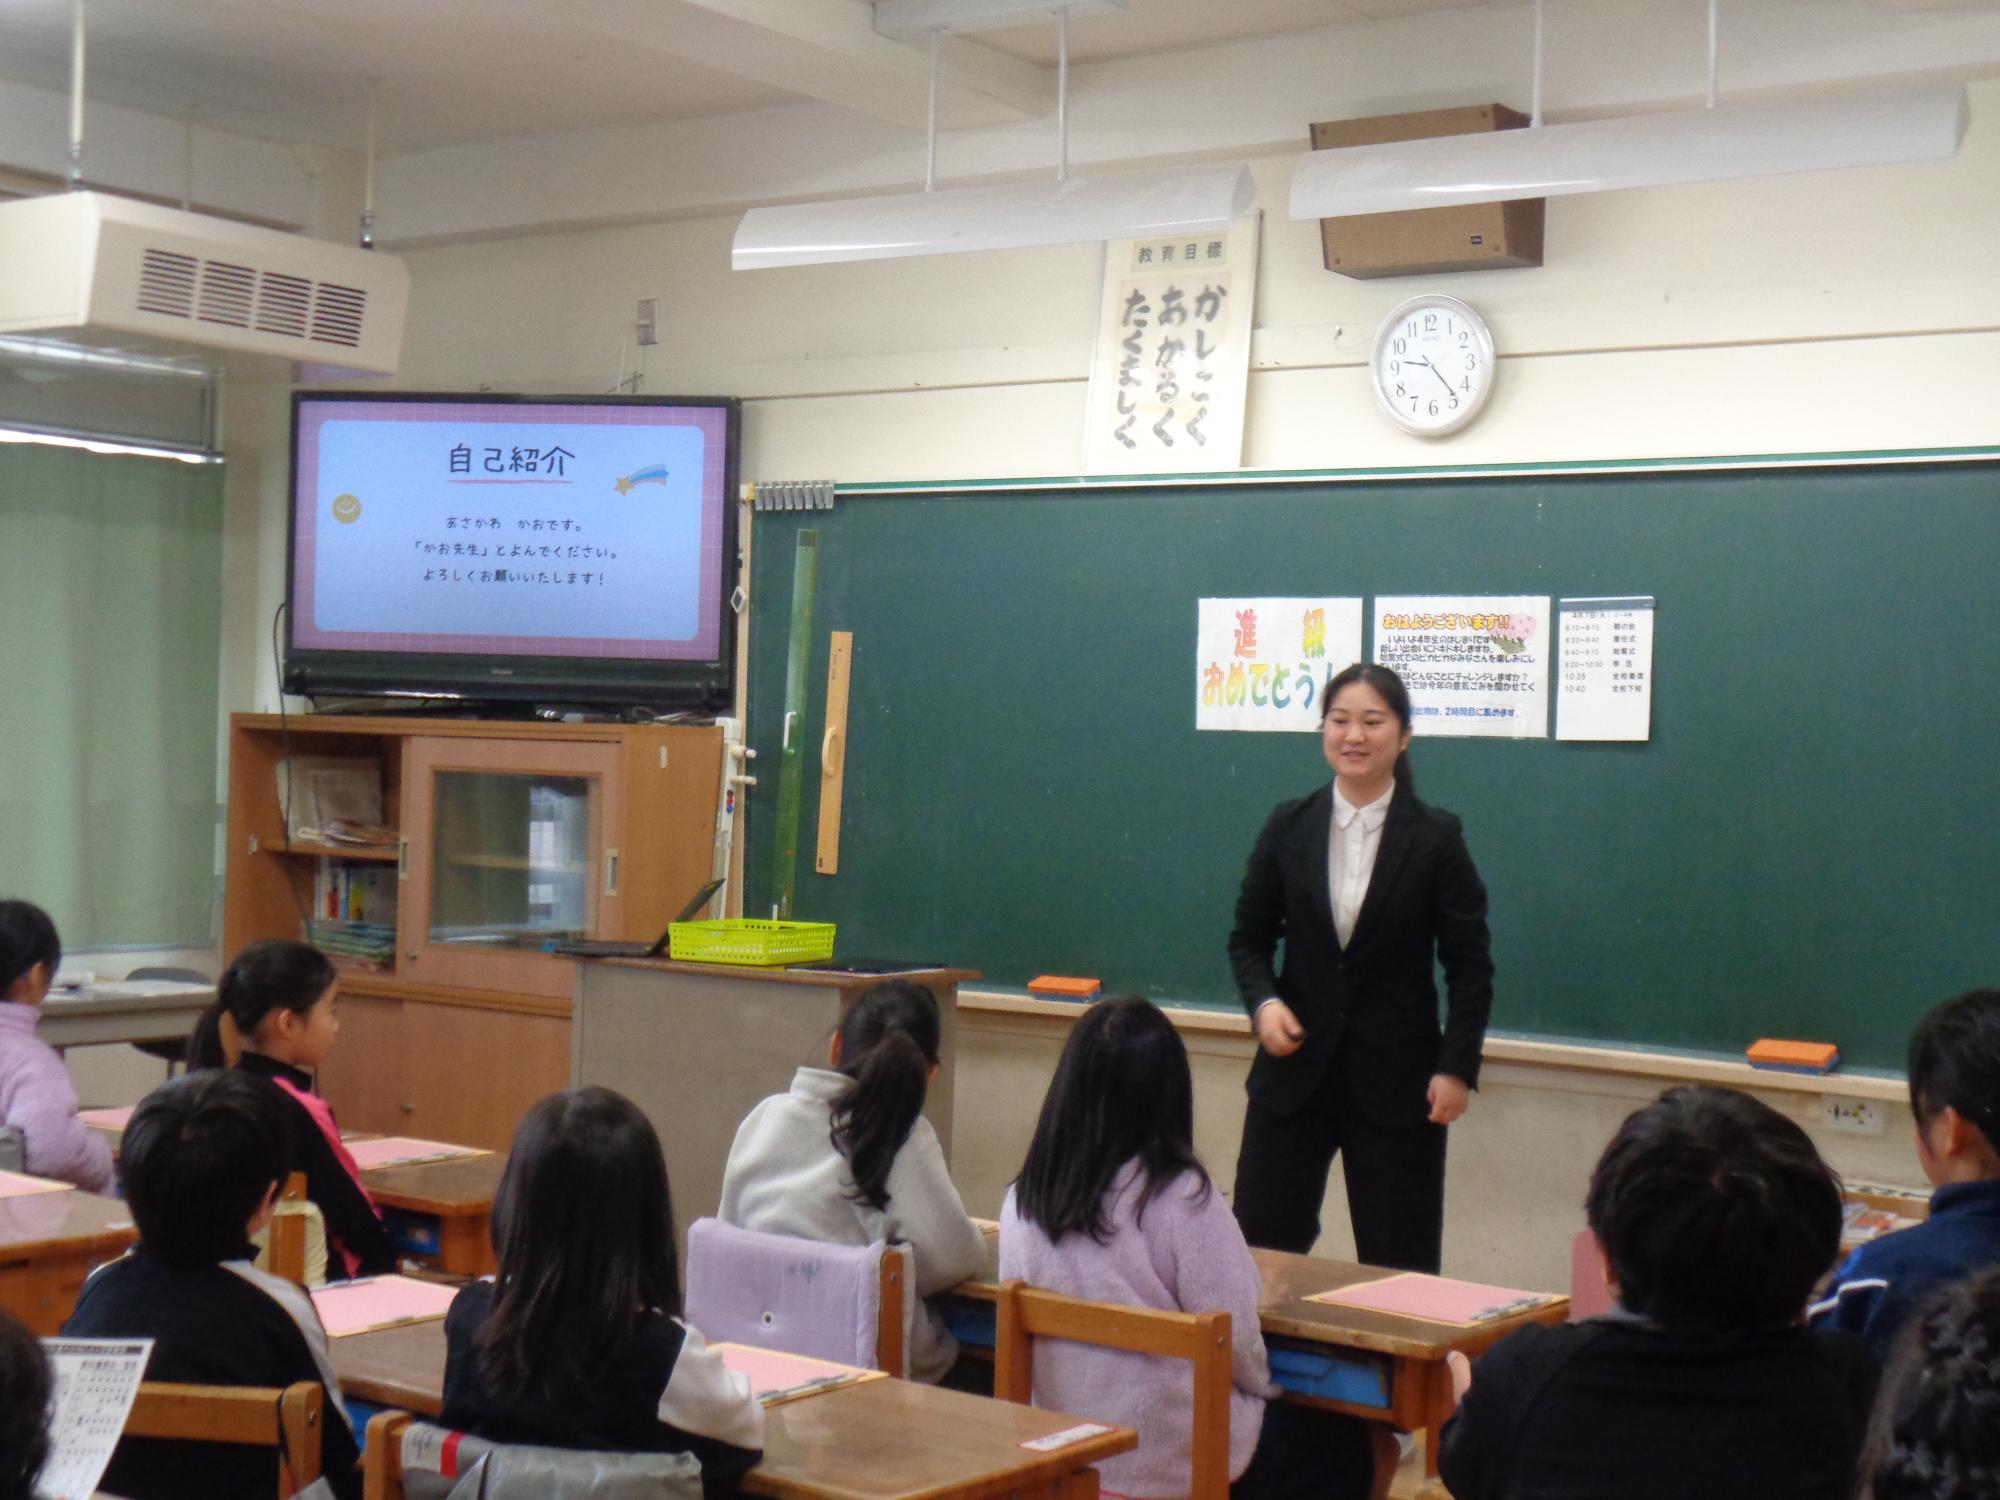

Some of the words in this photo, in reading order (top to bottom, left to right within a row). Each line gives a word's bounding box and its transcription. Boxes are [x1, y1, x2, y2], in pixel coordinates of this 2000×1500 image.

[1137, 241, 1223, 264] 教育目標
[1407, 321, 1417, 338] 11
[1425, 314, 1437, 332] 12
[1393, 338, 1406, 356] 10
[1459, 331, 1469, 348] 2
[1114, 288, 1152, 450] たくましく
[1152, 285, 1188, 448] あかるく
[1186, 284, 1227, 447] かしこく
[1390, 360, 1400, 377] 9
[1465, 353, 1475, 371] 3
[1396, 381, 1405, 398] 8
[1459, 375, 1471, 392] 4
[1409, 396, 1419, 412] 7
[1428, 399, 1439, 417] 6
[448, 443, 576, 477] 自己紹介
[517, 517, 582, 533] かおです。
[414, 540, 617, 560] 「かお先生」とよんでください。
[1234, 608, 1257, 658] 進
[1302, 607, 1326, 658] 級
